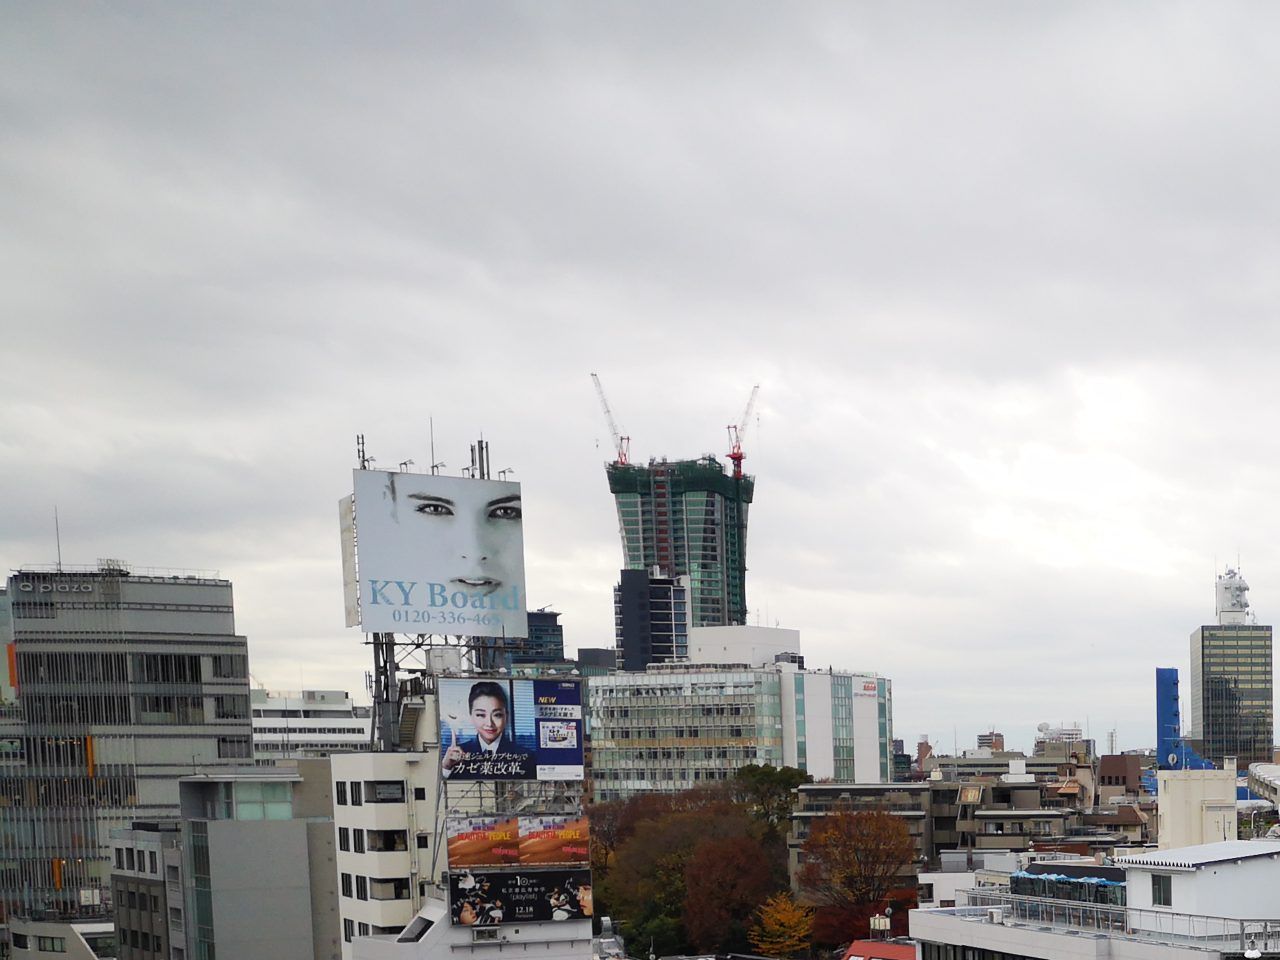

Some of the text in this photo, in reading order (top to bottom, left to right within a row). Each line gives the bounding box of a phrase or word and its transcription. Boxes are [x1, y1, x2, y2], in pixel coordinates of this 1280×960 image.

[40, 583, 92, 592] plaza
[368, 579, 520, 611] KY Board
[538, 696, 557, 704] NEW
